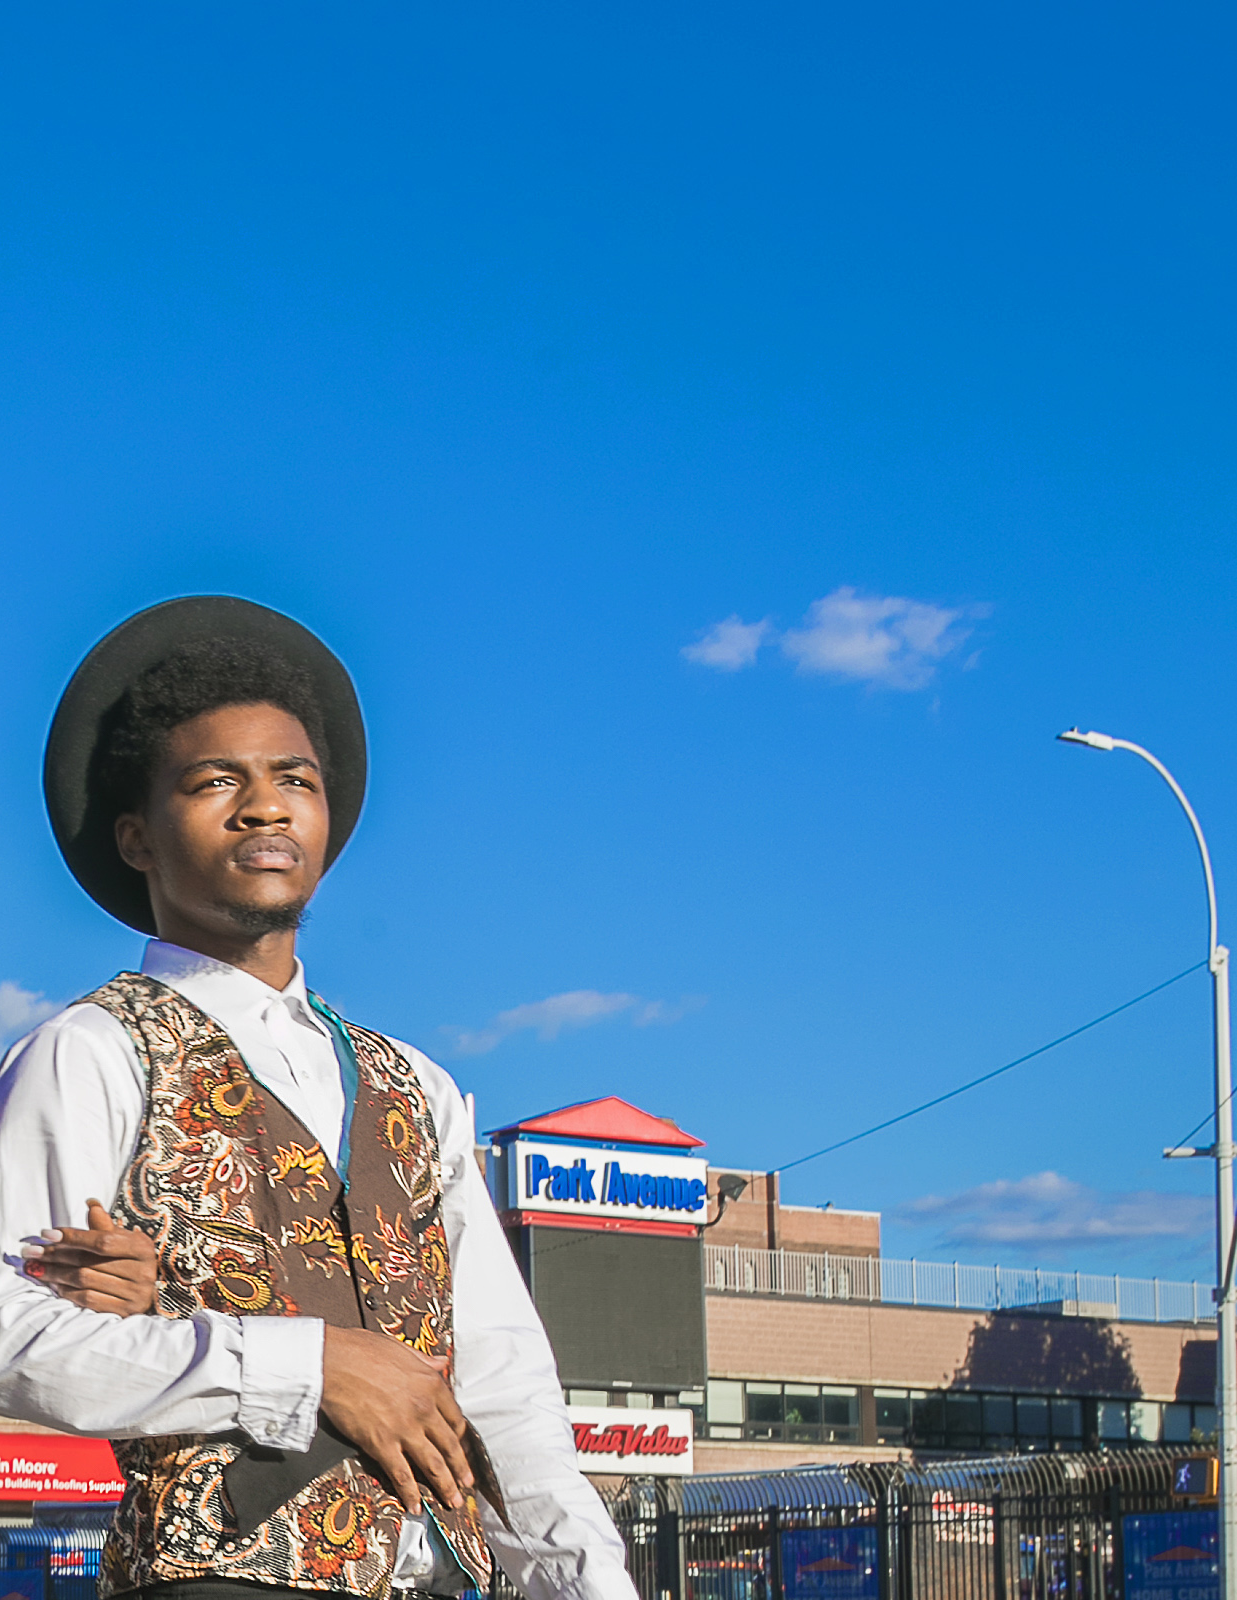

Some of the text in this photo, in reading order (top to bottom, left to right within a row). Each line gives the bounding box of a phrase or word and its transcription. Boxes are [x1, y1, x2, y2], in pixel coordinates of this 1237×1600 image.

[525, 1154, 706, 1213] Park Avenue
[572, 1423, 689, 1457] True Value
[12, 1457, 56, 1475] Moore
[4, 1477, 43, 1492] Building
[43, 1479, 52, 1490] &
[52, 1478, 88, 1493] Roofing
[88, 1480, 126, 1494] Supplies
